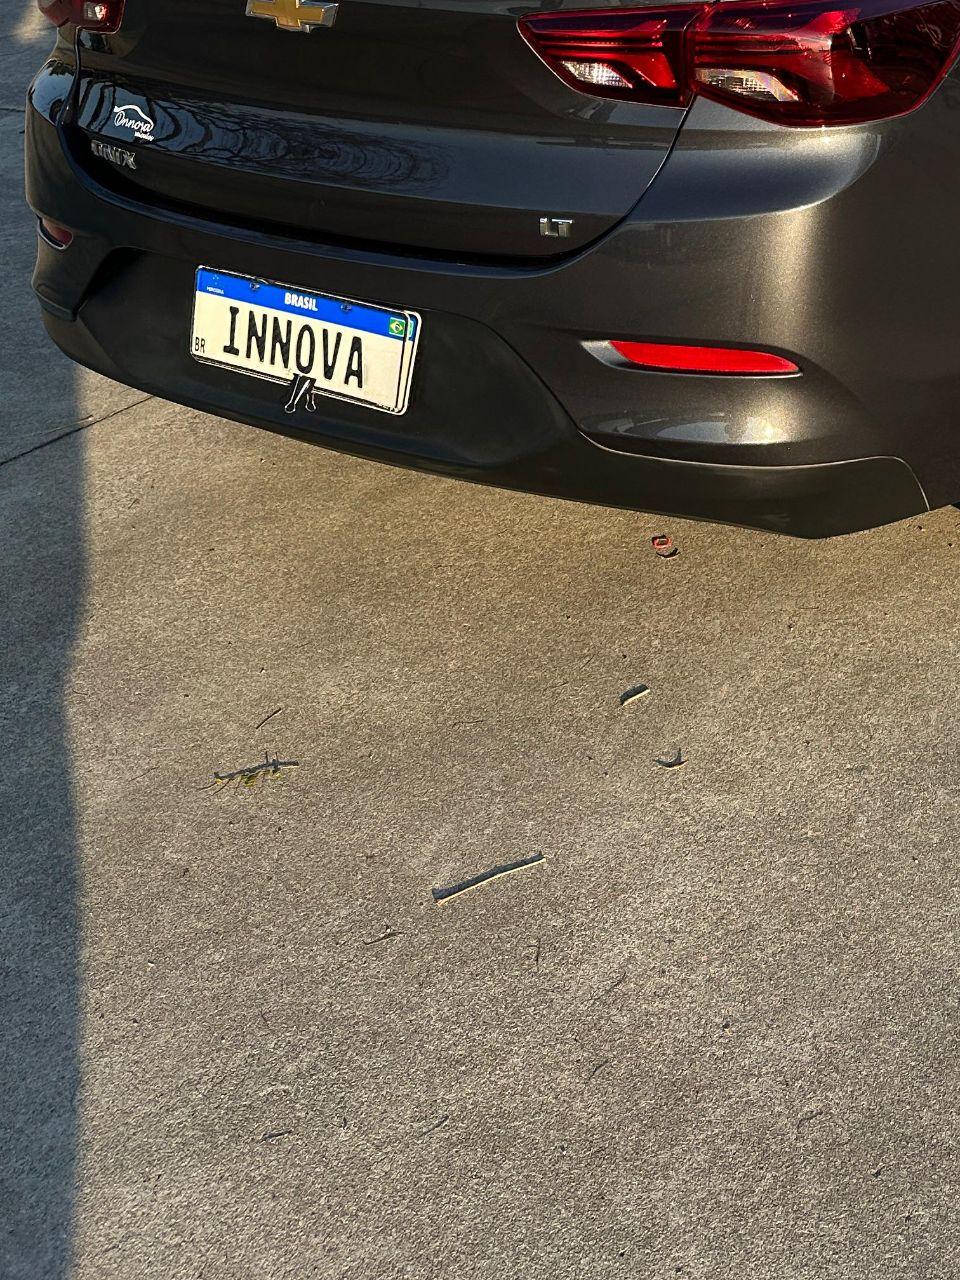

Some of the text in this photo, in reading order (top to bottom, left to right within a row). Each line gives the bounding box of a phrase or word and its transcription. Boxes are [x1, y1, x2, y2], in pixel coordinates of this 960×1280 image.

[539, 218, 573, 237] LT
[284, 292, 318, 311] BRASIL
[194, 336, 206, 353] BR
[223, 305, 364, 389] INNOVA
